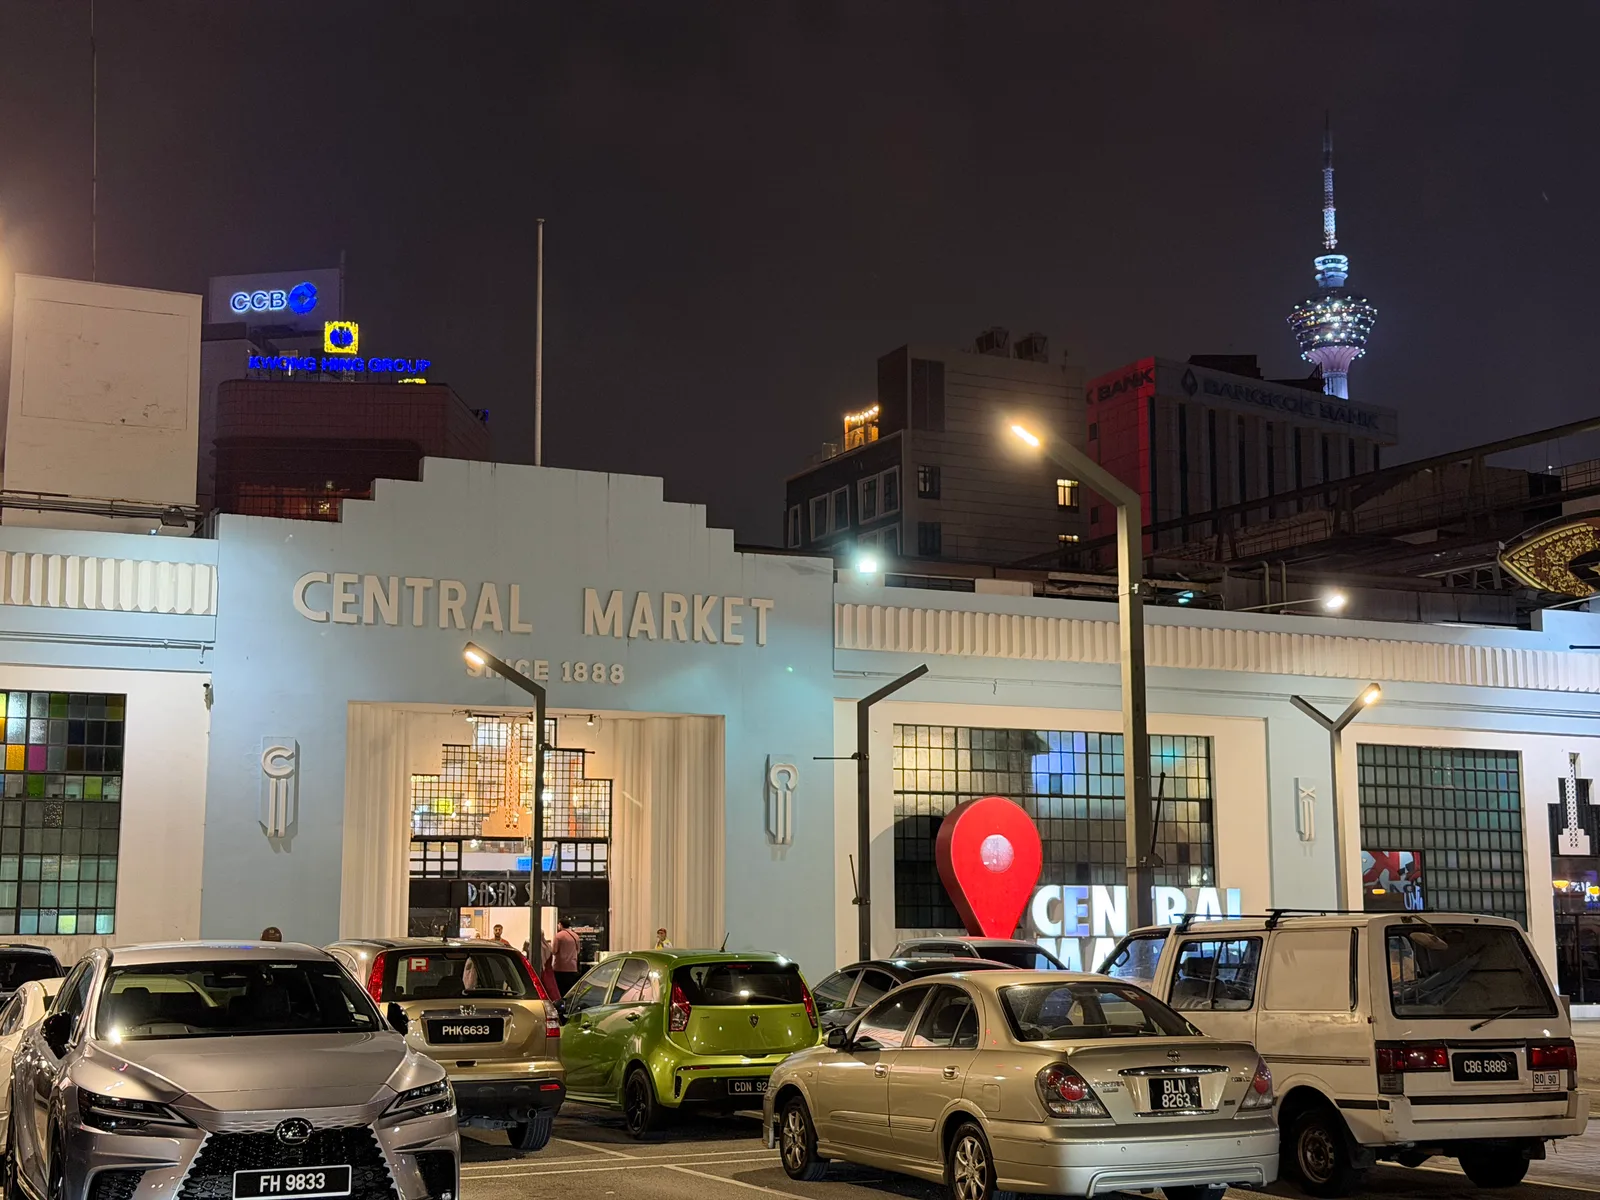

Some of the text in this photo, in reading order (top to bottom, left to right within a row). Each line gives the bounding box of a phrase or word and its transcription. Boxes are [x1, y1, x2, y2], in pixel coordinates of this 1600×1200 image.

[231, 290, 286, 312] CCB
[248, 356, 431, 374] KWONG HING GROUP
[1098, 368, 1154, 402] BANK
[1203, 379, 1380, 429] BANGKOK BANK
[293, 571, 774, 647] CENTRAL MARKET
[561, 661, 624, 684] 1888
[467, 881, 556, 906] PASAR SNI
[411, 959, 427, 970] P
[442, 1025, 490, 1036] PHK6633
[1464, 1060, 1507, 1073] CBG 5889
[734, 1081, 768, 1092] CDN 92
[1163, 1079, 1186, 1093] BLN
[1534, 1074, 1557, 1084] 80 90
[1162, 1093, 1191, 1108] 8263
[260, 1172, 326, 1193] FH 9833
